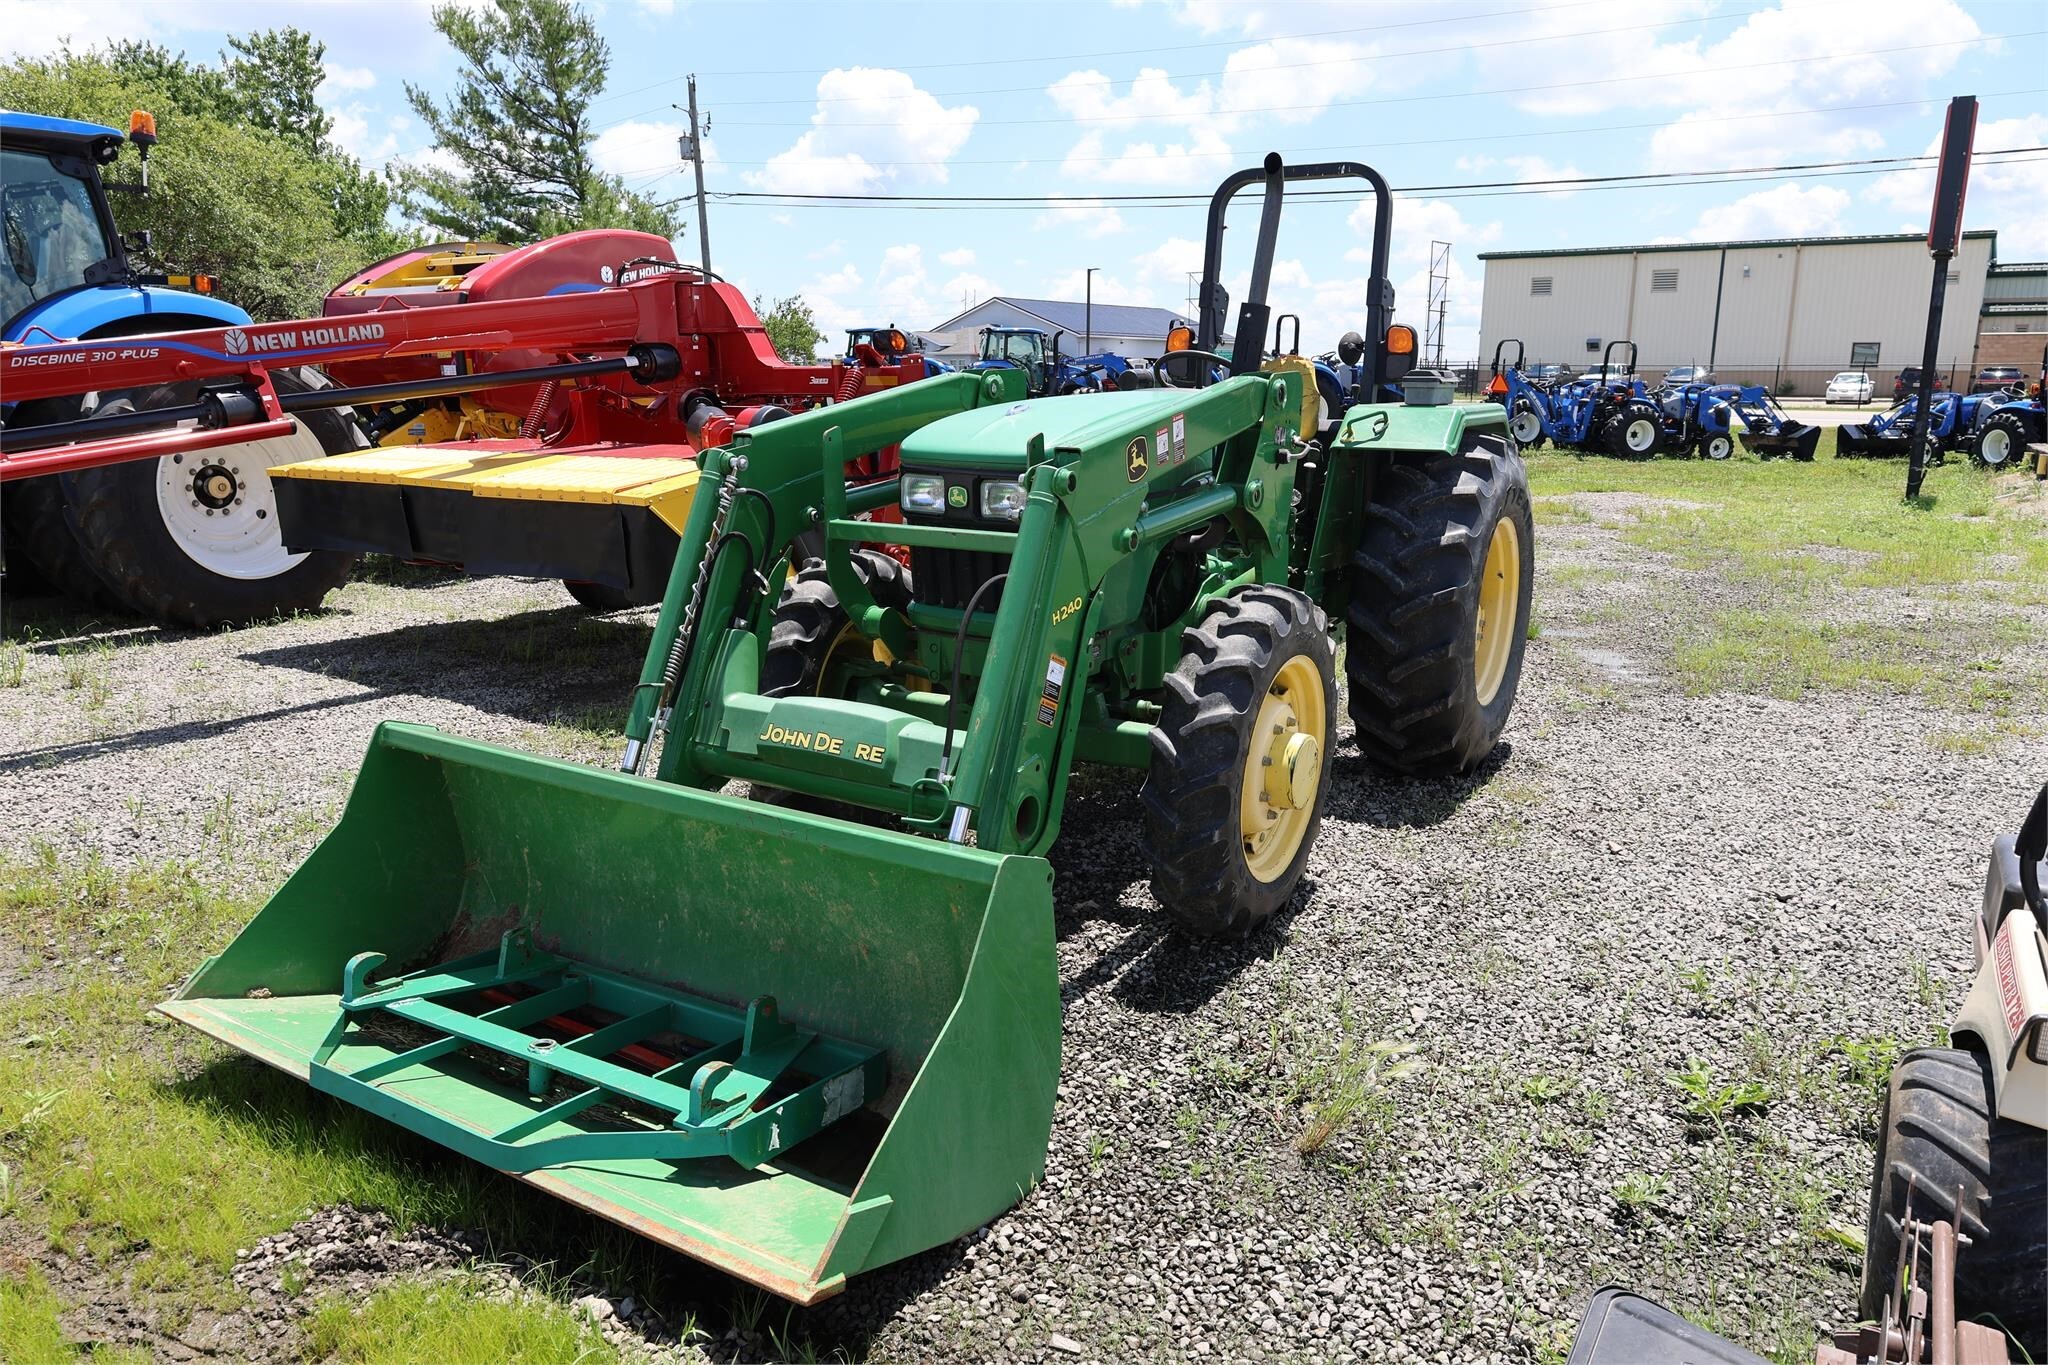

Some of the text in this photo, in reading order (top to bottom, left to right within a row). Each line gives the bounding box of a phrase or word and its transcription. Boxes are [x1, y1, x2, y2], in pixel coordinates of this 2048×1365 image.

[251, 323, 385, 352] NEW HOLLAND
[11, 352, 87, 368] DISCBINE
[90, 351, 117, 362] 310
[1051, 596, 1083, 626] H240
[759, 722, 812, 749] JOHN
